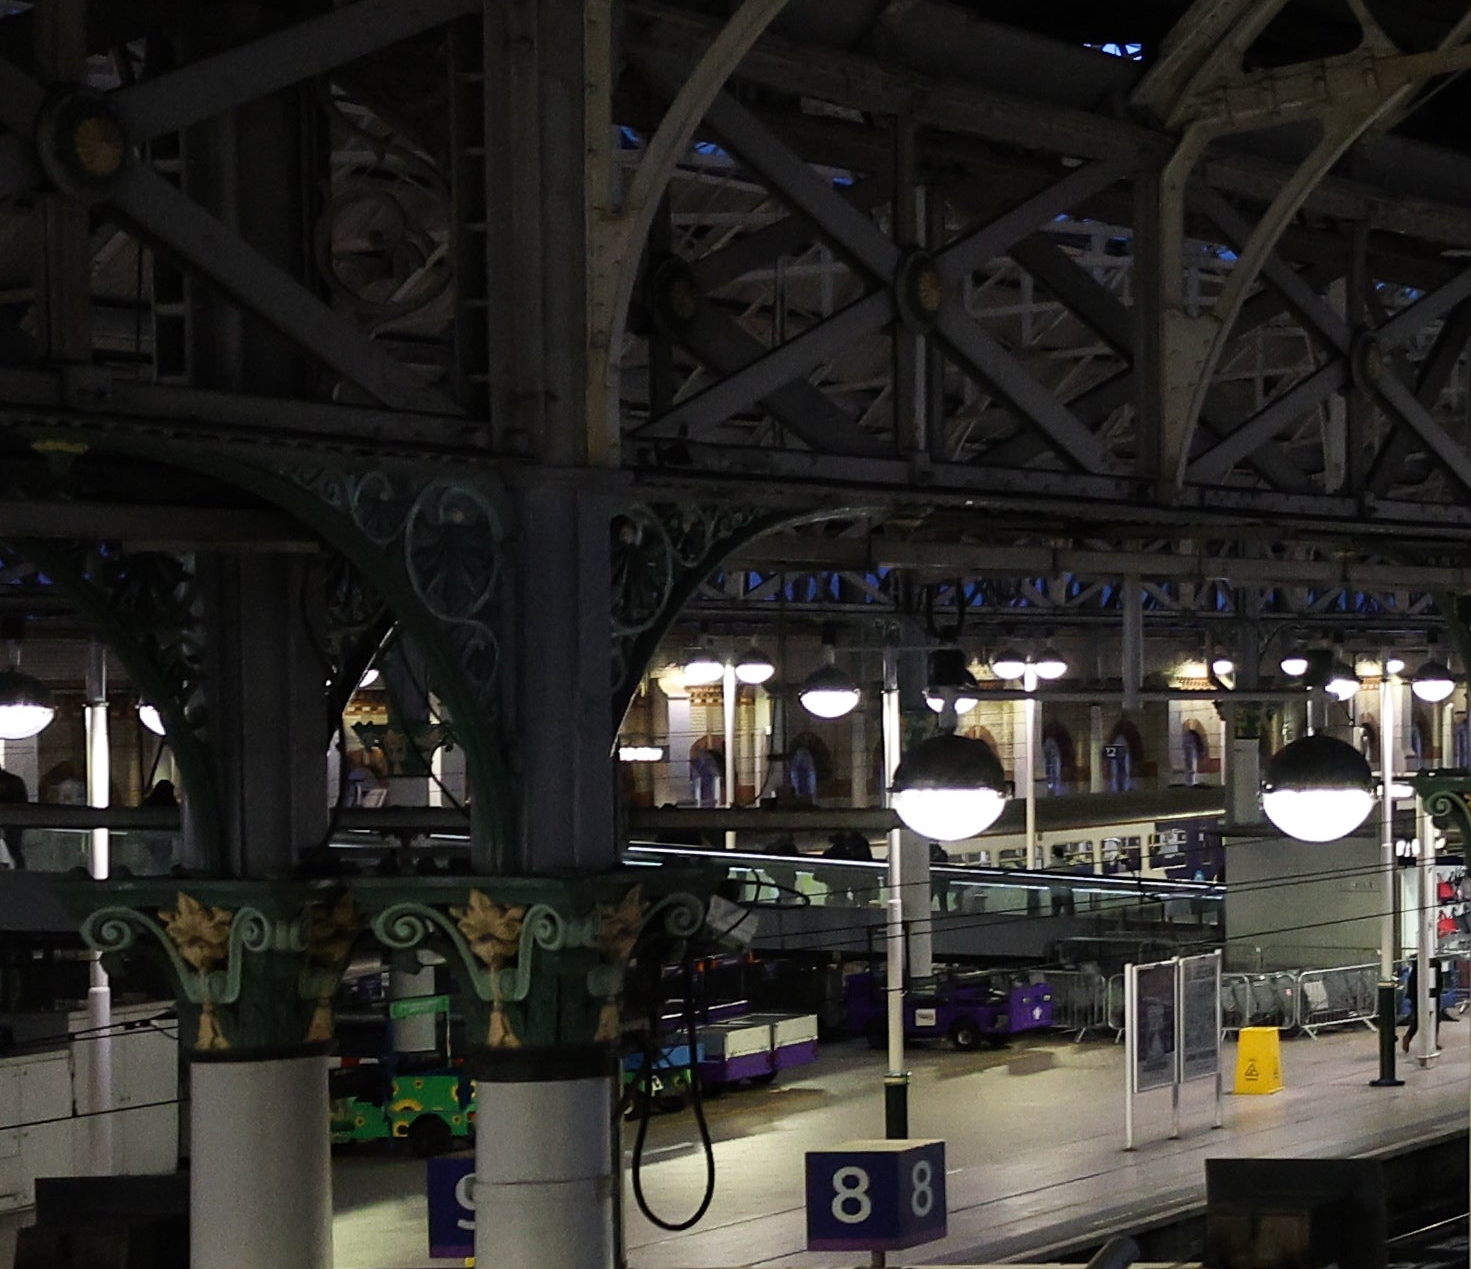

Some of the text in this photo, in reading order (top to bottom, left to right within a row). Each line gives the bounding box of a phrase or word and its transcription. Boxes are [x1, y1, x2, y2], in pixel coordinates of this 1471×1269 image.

[454, 1173, 476, 1230] 9
[831, 1165, 873, 1225] 8
[912, 1159, 934, 1218] 8
